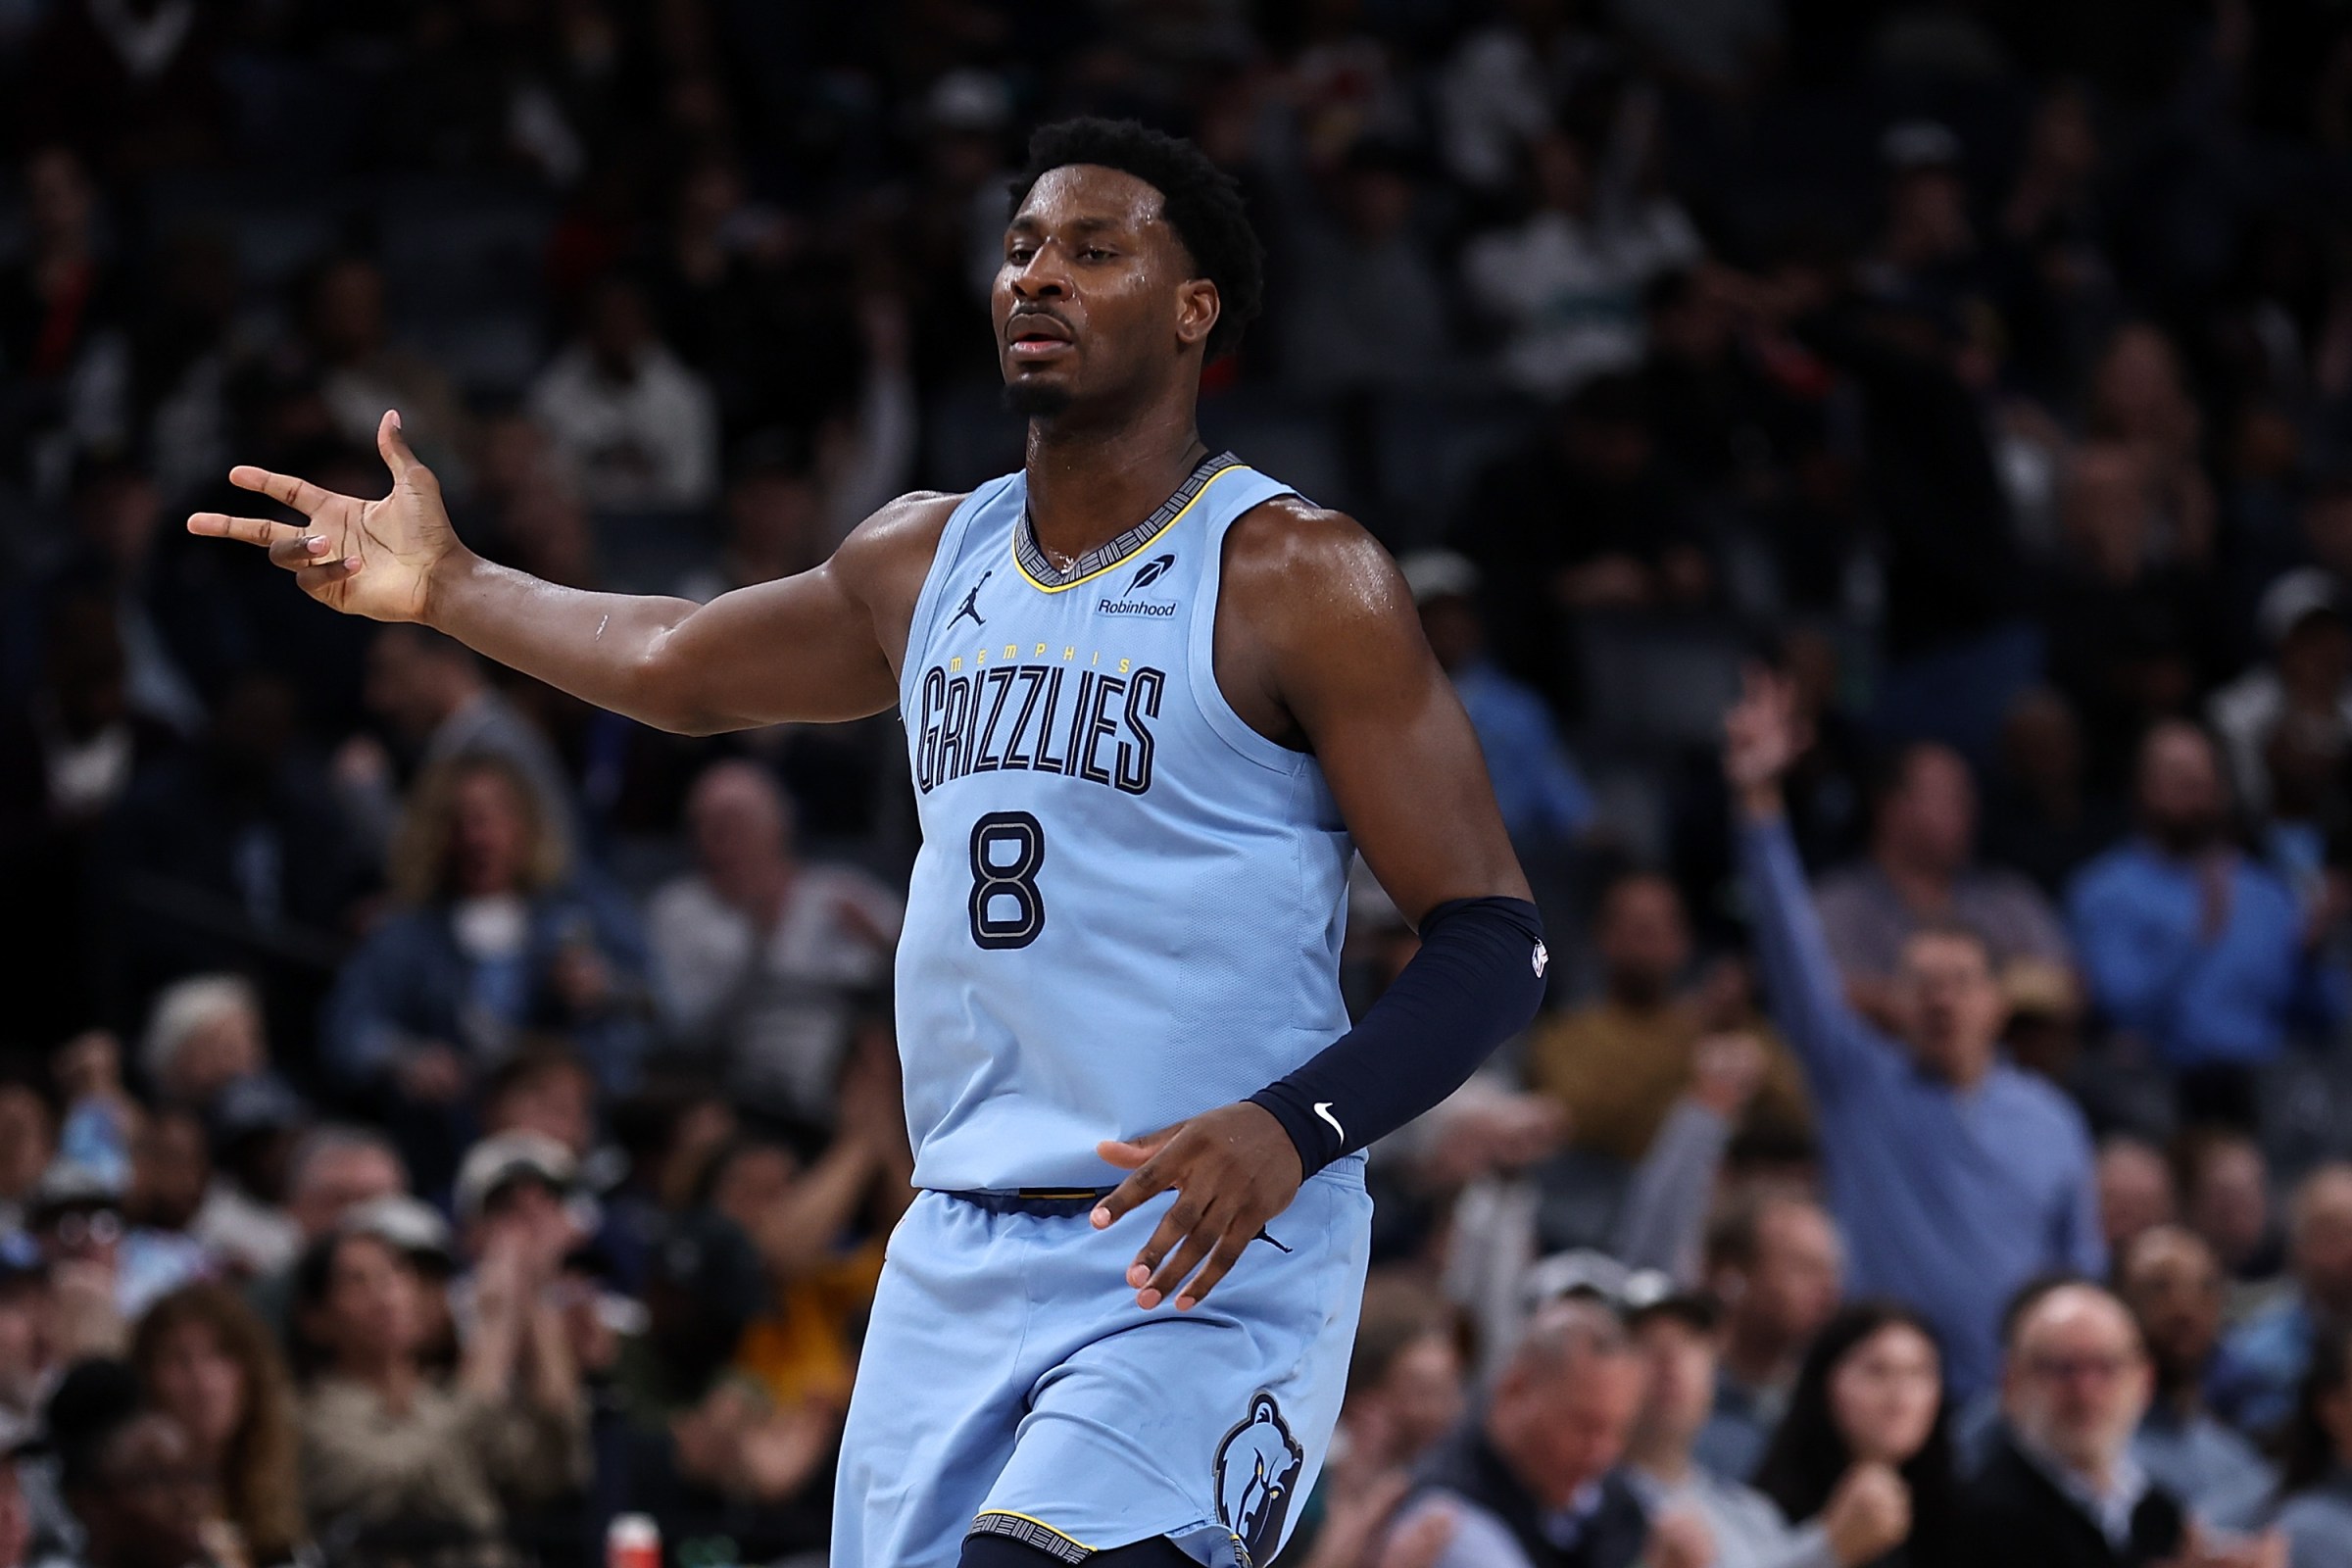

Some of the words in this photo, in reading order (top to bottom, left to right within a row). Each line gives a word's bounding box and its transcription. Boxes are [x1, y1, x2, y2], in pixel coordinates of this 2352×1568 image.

[1099, 599, 1176, 616] Robinhood
[949, 643, 1130, 673] MEMPHIS
[917, 665, 1166, 796] GRIZZLIES
[968, 810, 1045, 950] 8
